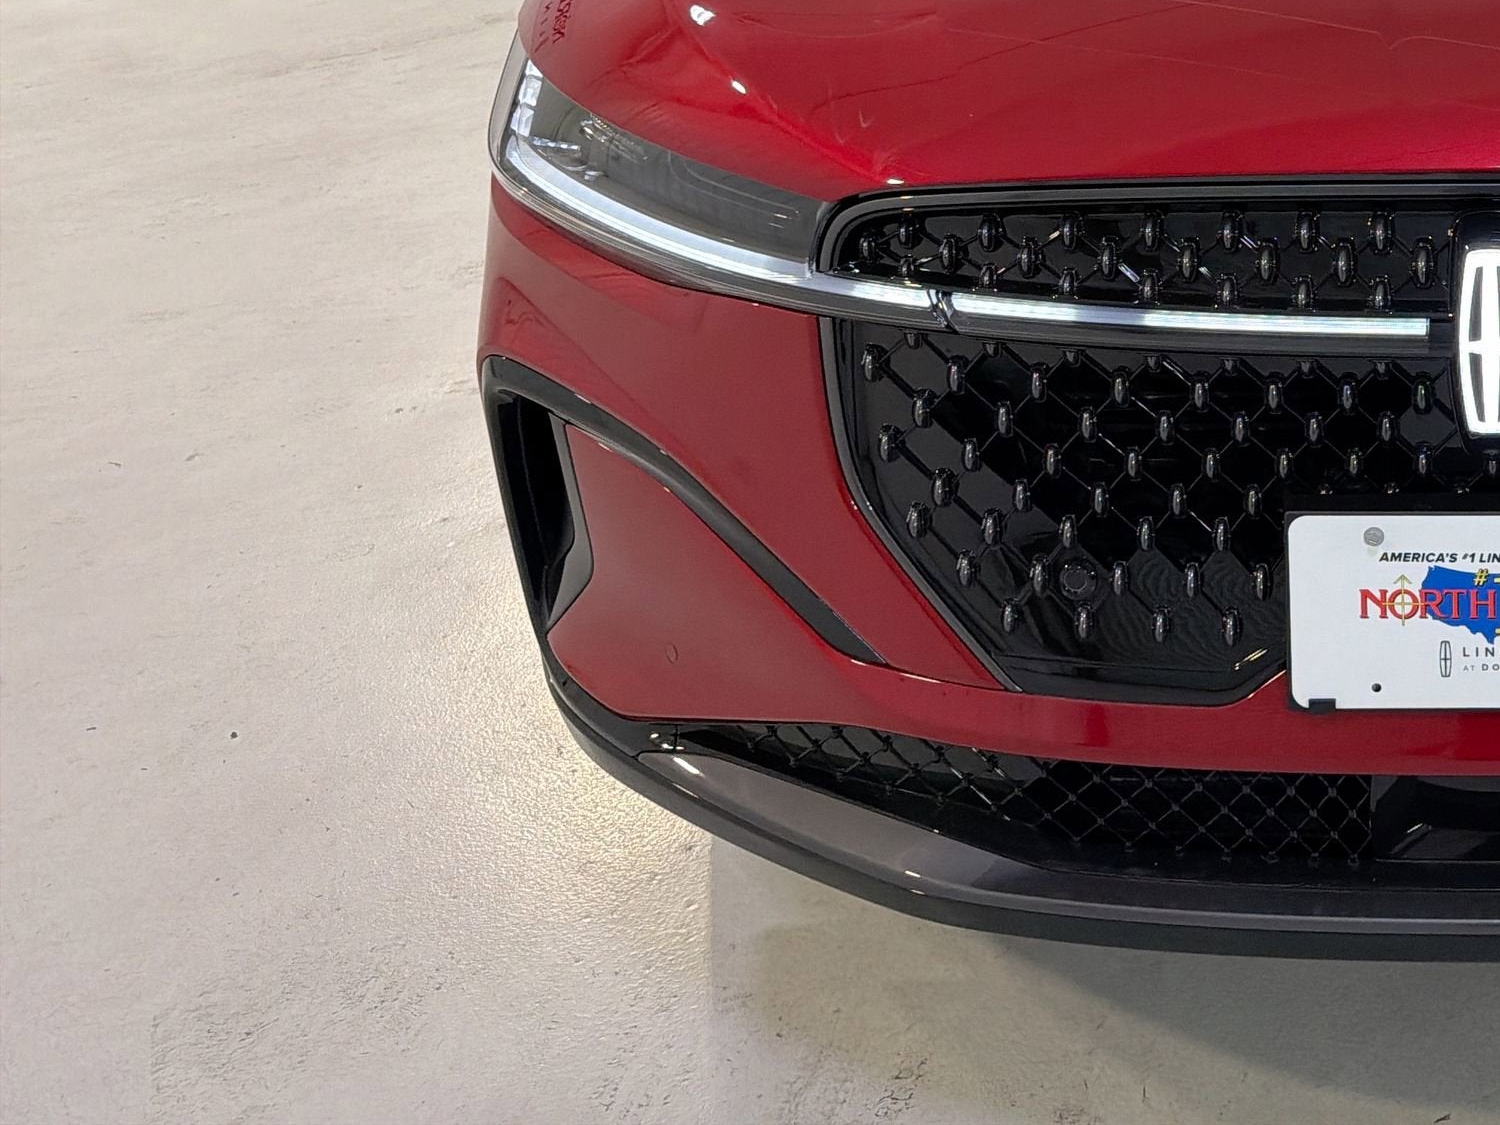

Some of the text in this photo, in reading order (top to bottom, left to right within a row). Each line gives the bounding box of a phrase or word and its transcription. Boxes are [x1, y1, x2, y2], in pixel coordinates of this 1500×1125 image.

[1379, 552, 1458, 564] AMERICA'S
[1462, 552, 1475, 563] #1
[1358, 588, 1496, 619] NORTH
